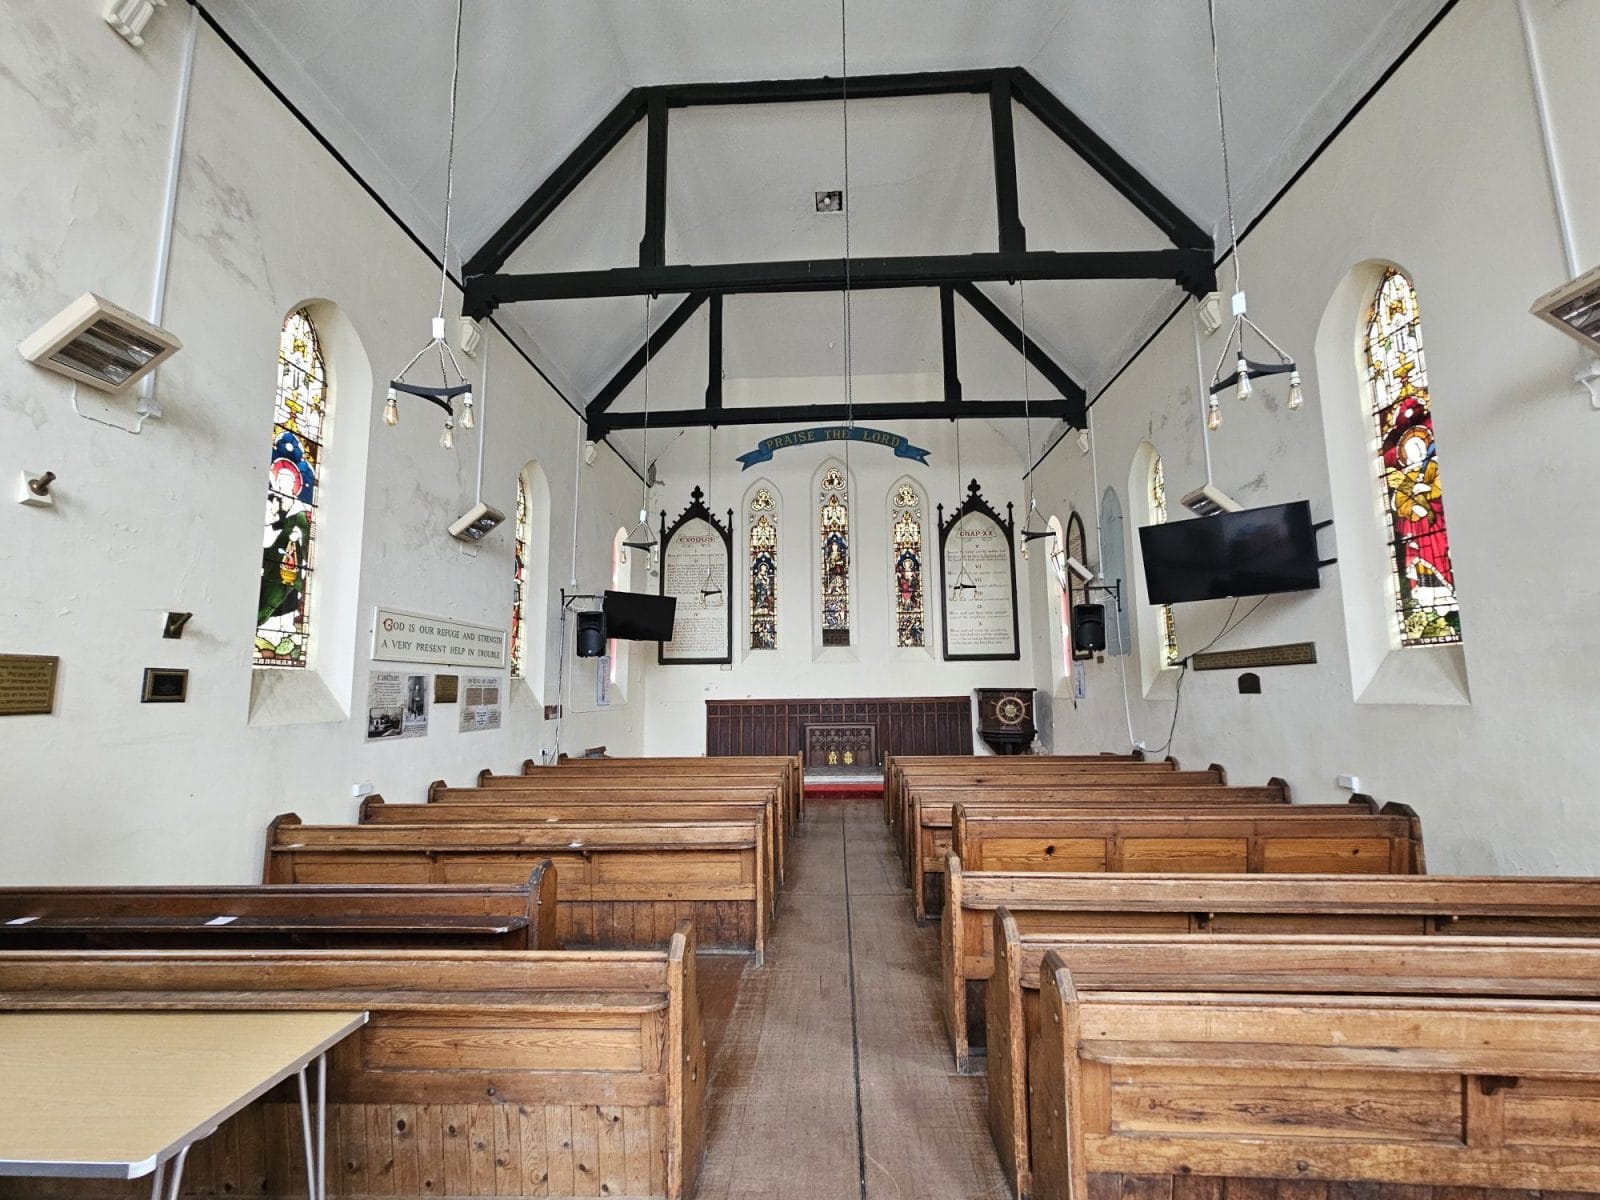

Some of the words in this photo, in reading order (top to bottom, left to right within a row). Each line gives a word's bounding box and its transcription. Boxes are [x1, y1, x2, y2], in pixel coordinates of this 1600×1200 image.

[766, 430, 815, 450] PRAISE
[824, 429, 849, 440] THE
[863, 431, 900, 448] LORD
[383, 618, 405, 632] GOD
[408, 623, 415, 632] IS
[419, 625, 434, 635] OUR
[436, 628, 460, 639] REFUGE
[462, 632, 475, 641] AND
[477, 634, 503, 645] STRENGTH
[381, 640, 388, 648] A
[392, 640, 412, 650] VERY
[416, 642, 446, 654] PRESENT
[449, 646, 466, 655] HELP
[477, 649, 500, 659] TROUBLE
